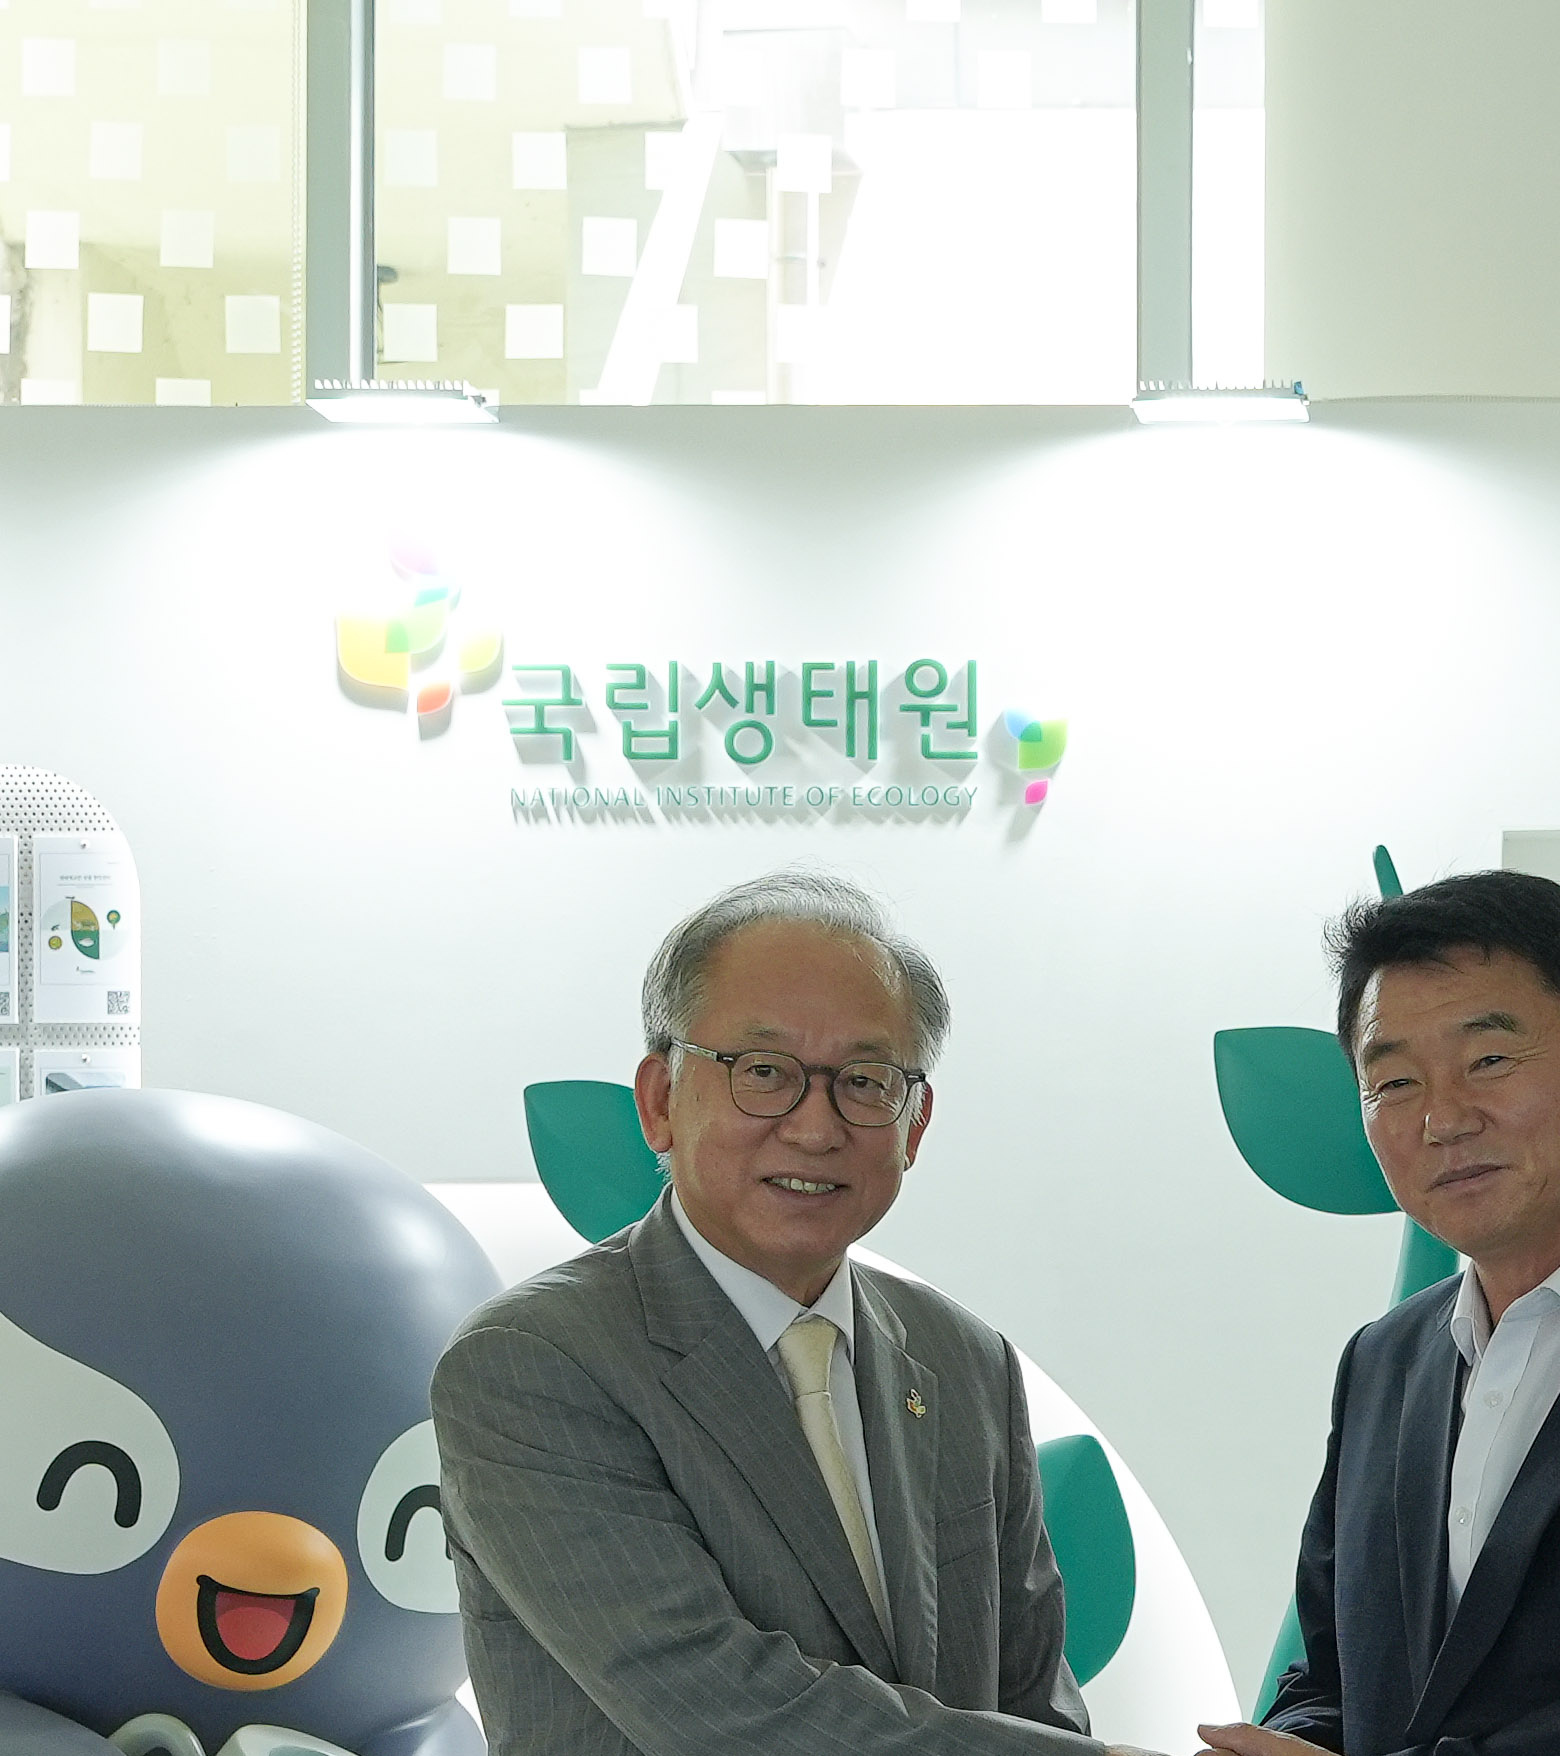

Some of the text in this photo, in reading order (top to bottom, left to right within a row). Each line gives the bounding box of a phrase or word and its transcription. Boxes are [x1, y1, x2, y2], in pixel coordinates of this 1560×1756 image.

[502, 658, 979, 765] 국립생태원
[511, 785, 979, 808] NATIONAL INSTITUTE OF ECOLOGY
